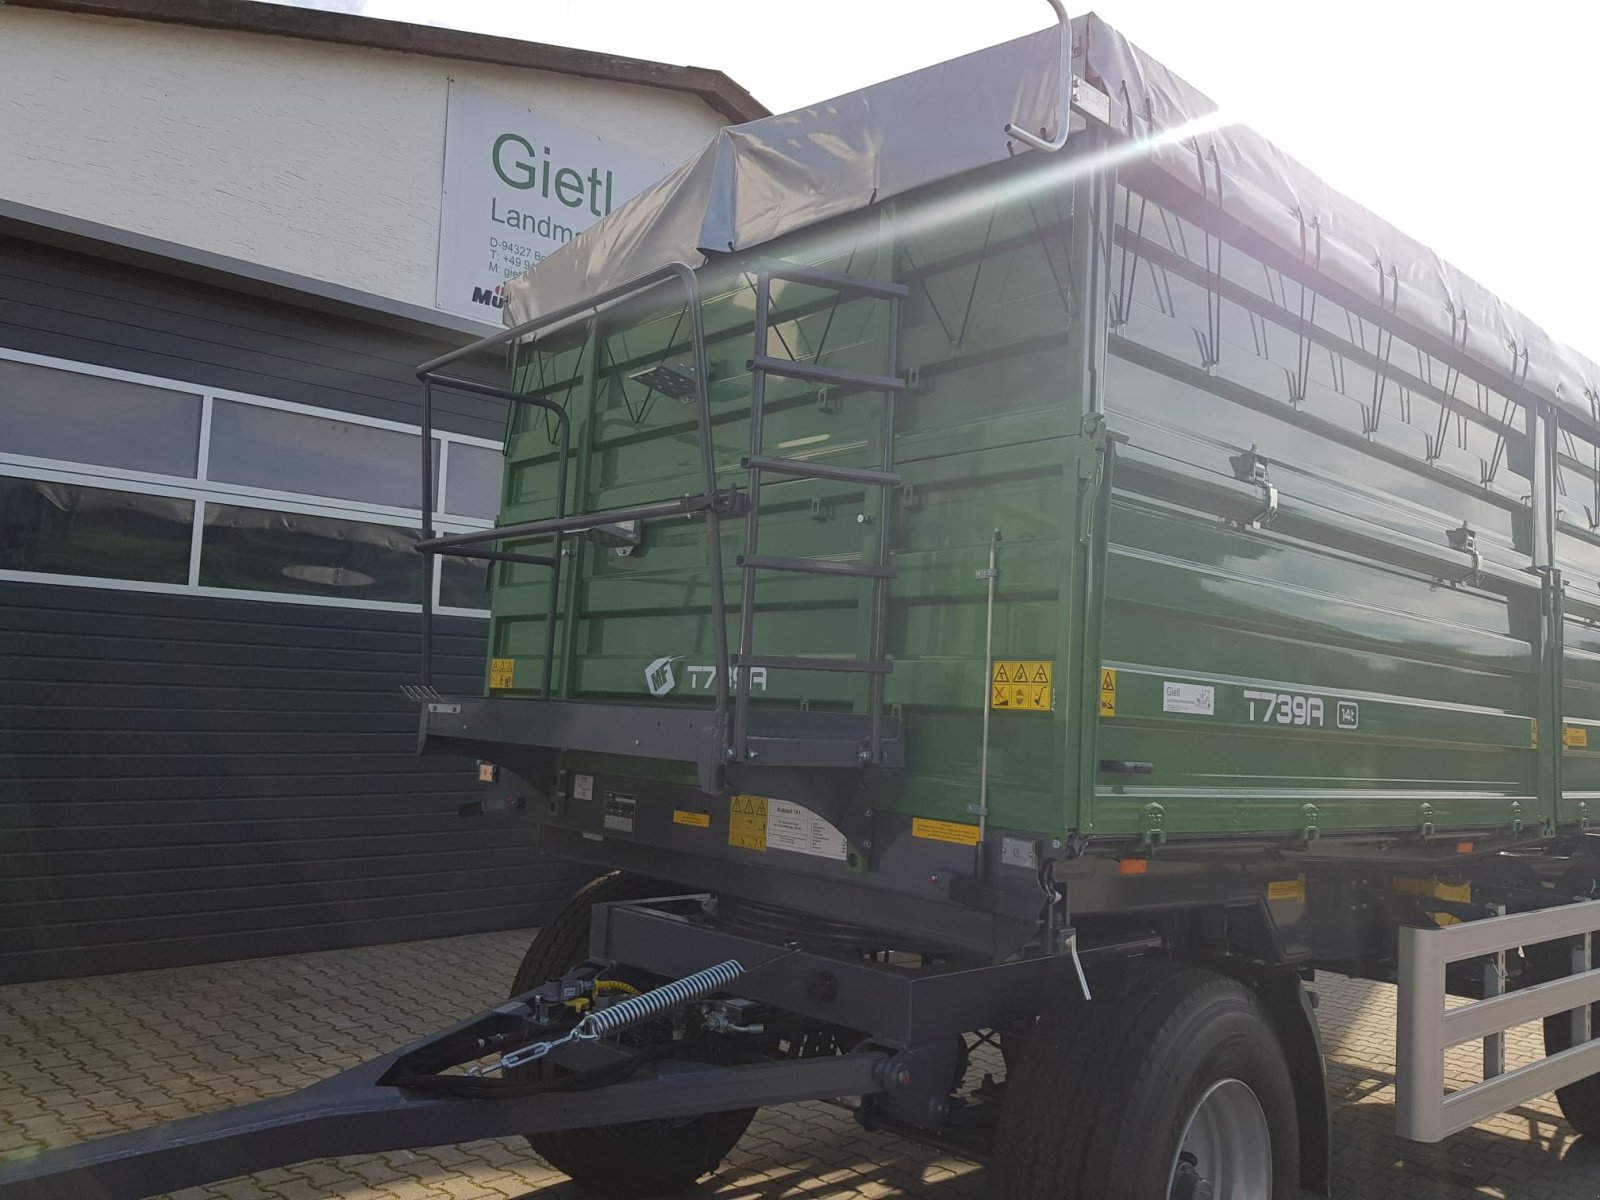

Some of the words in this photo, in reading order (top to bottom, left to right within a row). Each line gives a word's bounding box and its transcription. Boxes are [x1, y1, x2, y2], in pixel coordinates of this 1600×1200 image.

[491, 132, 613, 218] Gietl
[489, 236, 532, 258] D-94327
[503, 255, 522, 268] +49
[1243, 689, 1324, 727] T739A
